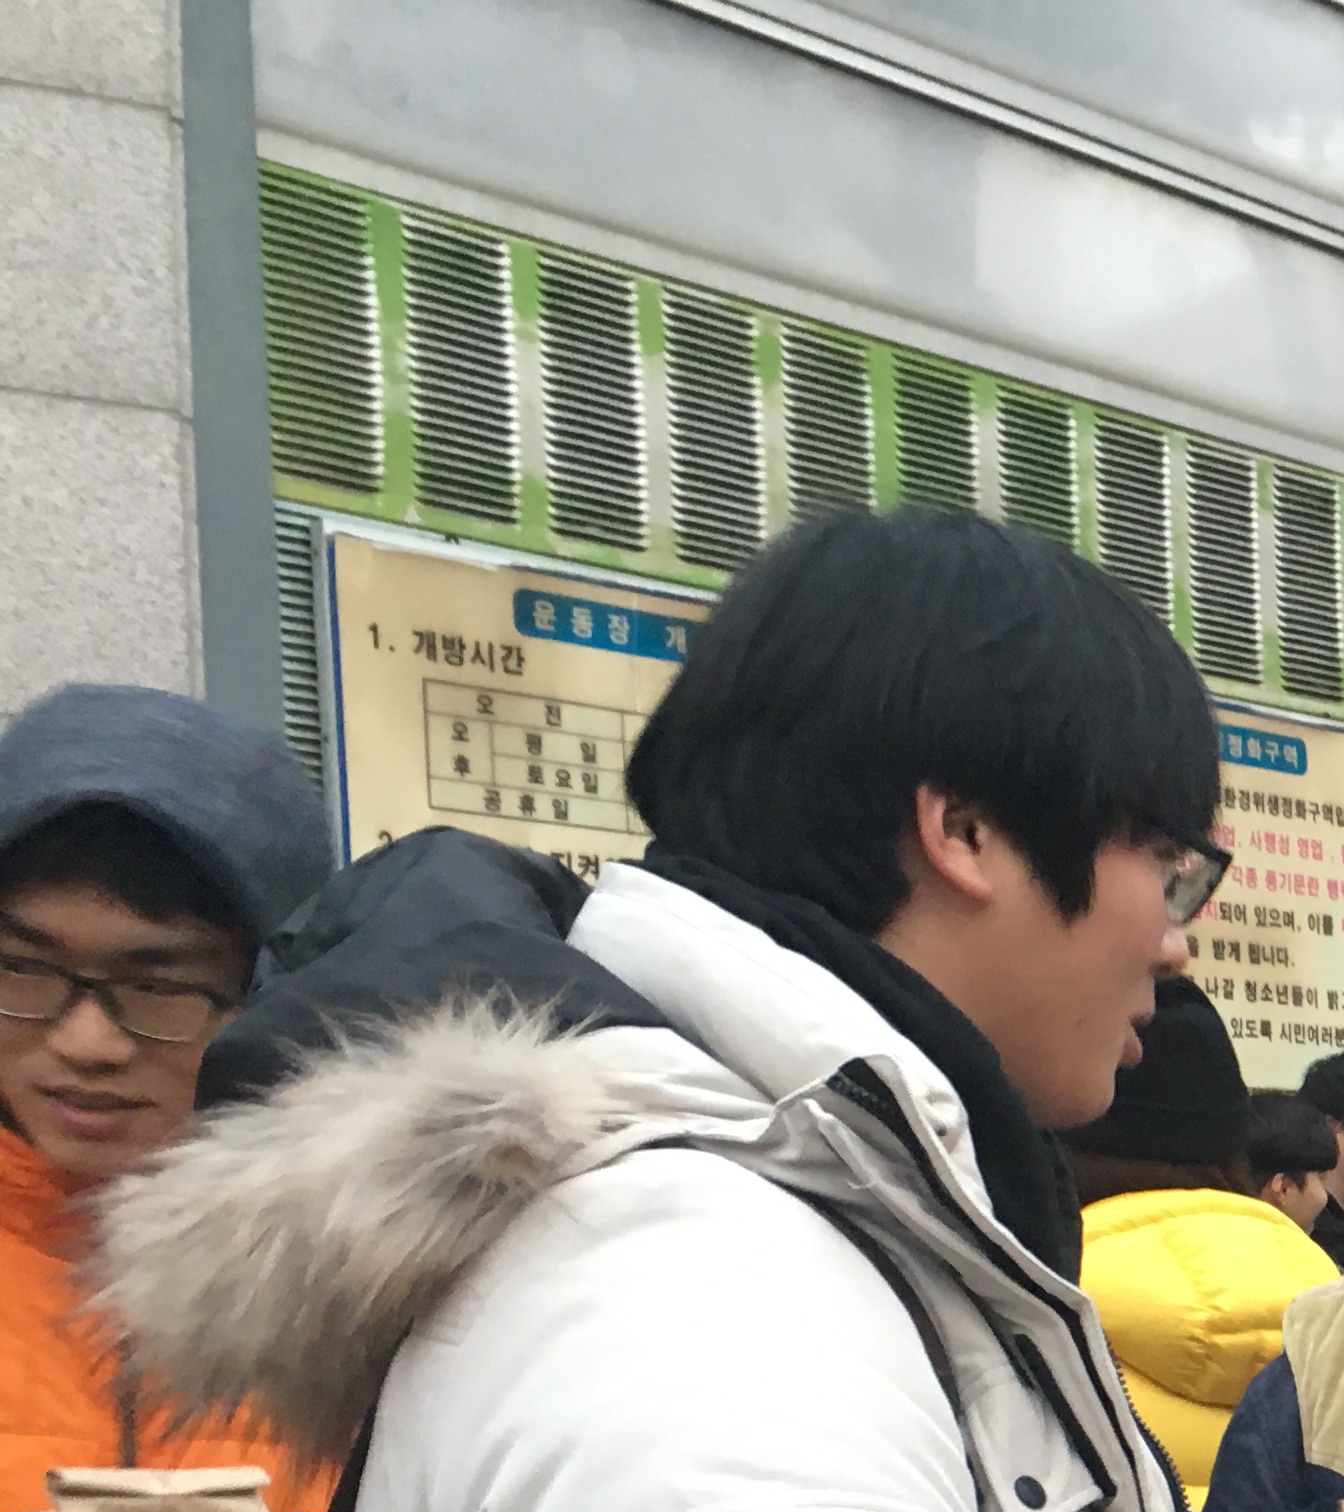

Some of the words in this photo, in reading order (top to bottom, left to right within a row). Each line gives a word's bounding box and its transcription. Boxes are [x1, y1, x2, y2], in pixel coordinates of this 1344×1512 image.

[532, 600, 630, 644] 운동장
[368, 623, 396, 652] 1.
[411, 629, 525, 676] 개방시간
[1218, 731, 1298, 769] 정화구역
[1307, 913, 1334, 936] 이를
[1212, 938, 1241, 963] 받게
[1247, 943, 1295, 968] 됩니다.
[1205, 976, 1235, 1001] 나갈
[1244, 979, 1319, 1009] 청소년들이
[1231, 1017, 1273, 1042] 있도록
